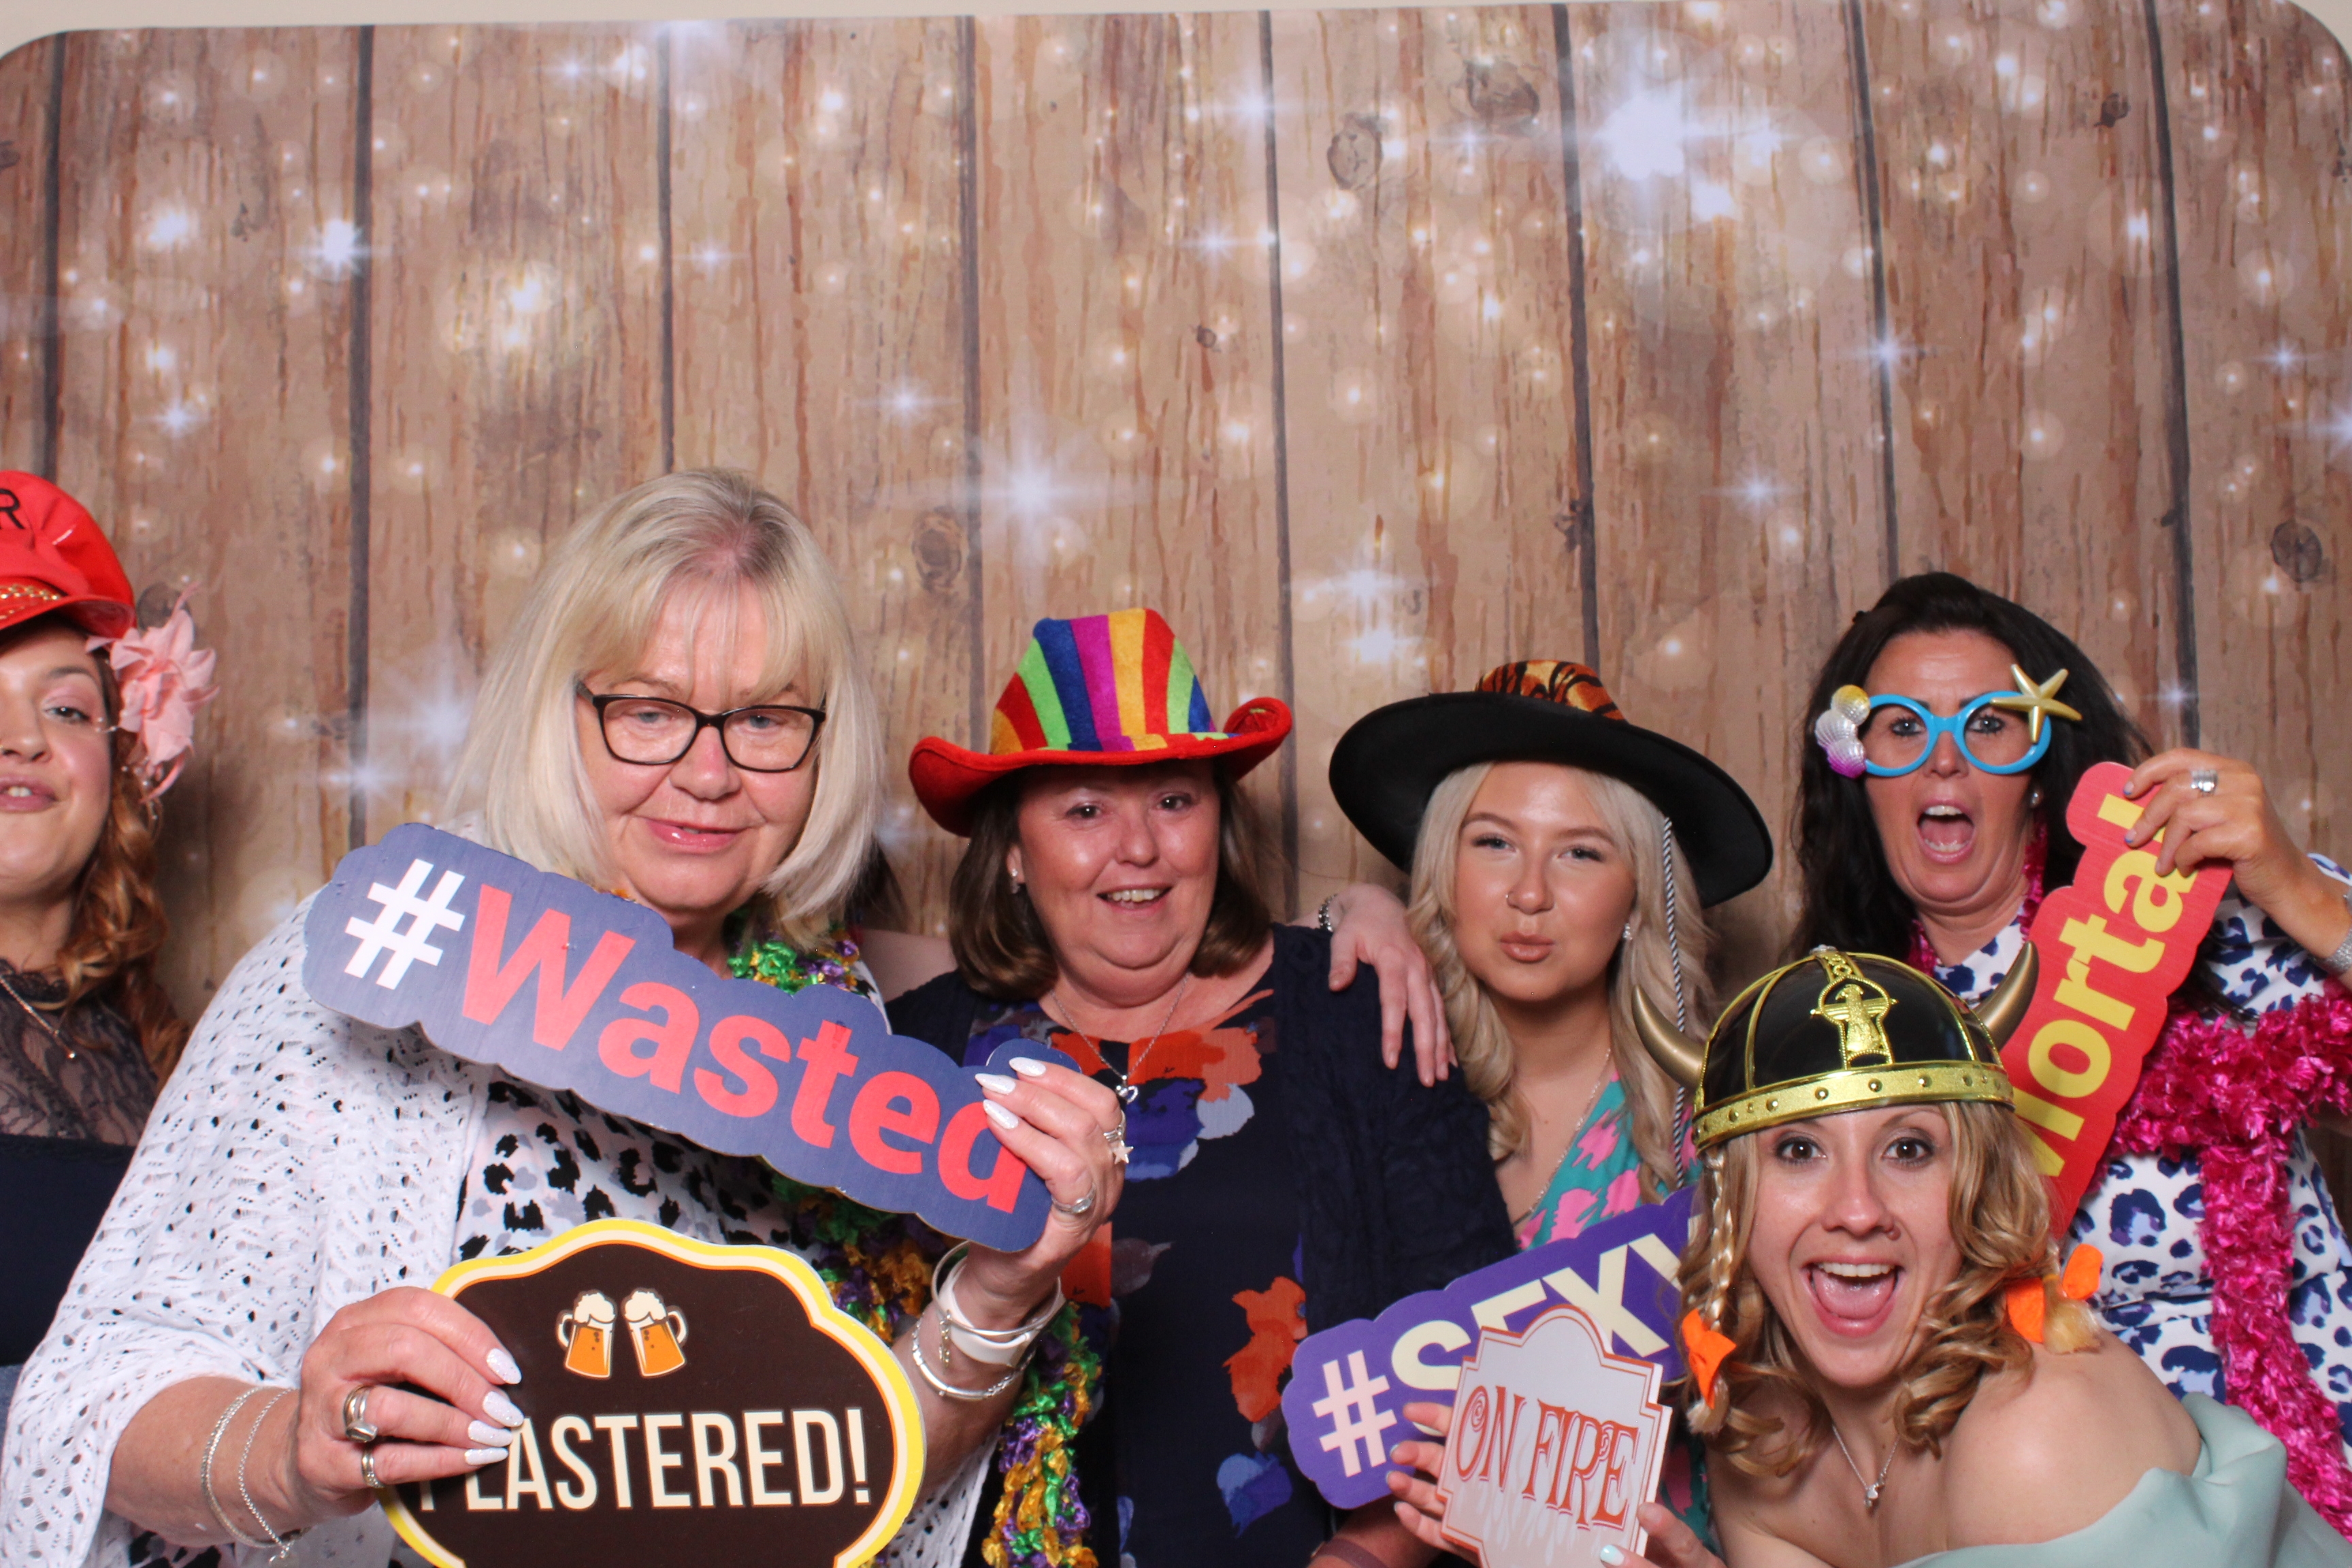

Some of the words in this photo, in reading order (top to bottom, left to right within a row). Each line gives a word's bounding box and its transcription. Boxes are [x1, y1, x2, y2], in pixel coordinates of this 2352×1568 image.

[344, 858, 1028, 1213] #Wasted
[419, 1408, 870, 1511] LASTERED!
[1456, 1385, 1526, 1492] ON
[1522, 1398, 1641, 1531] FIRE
